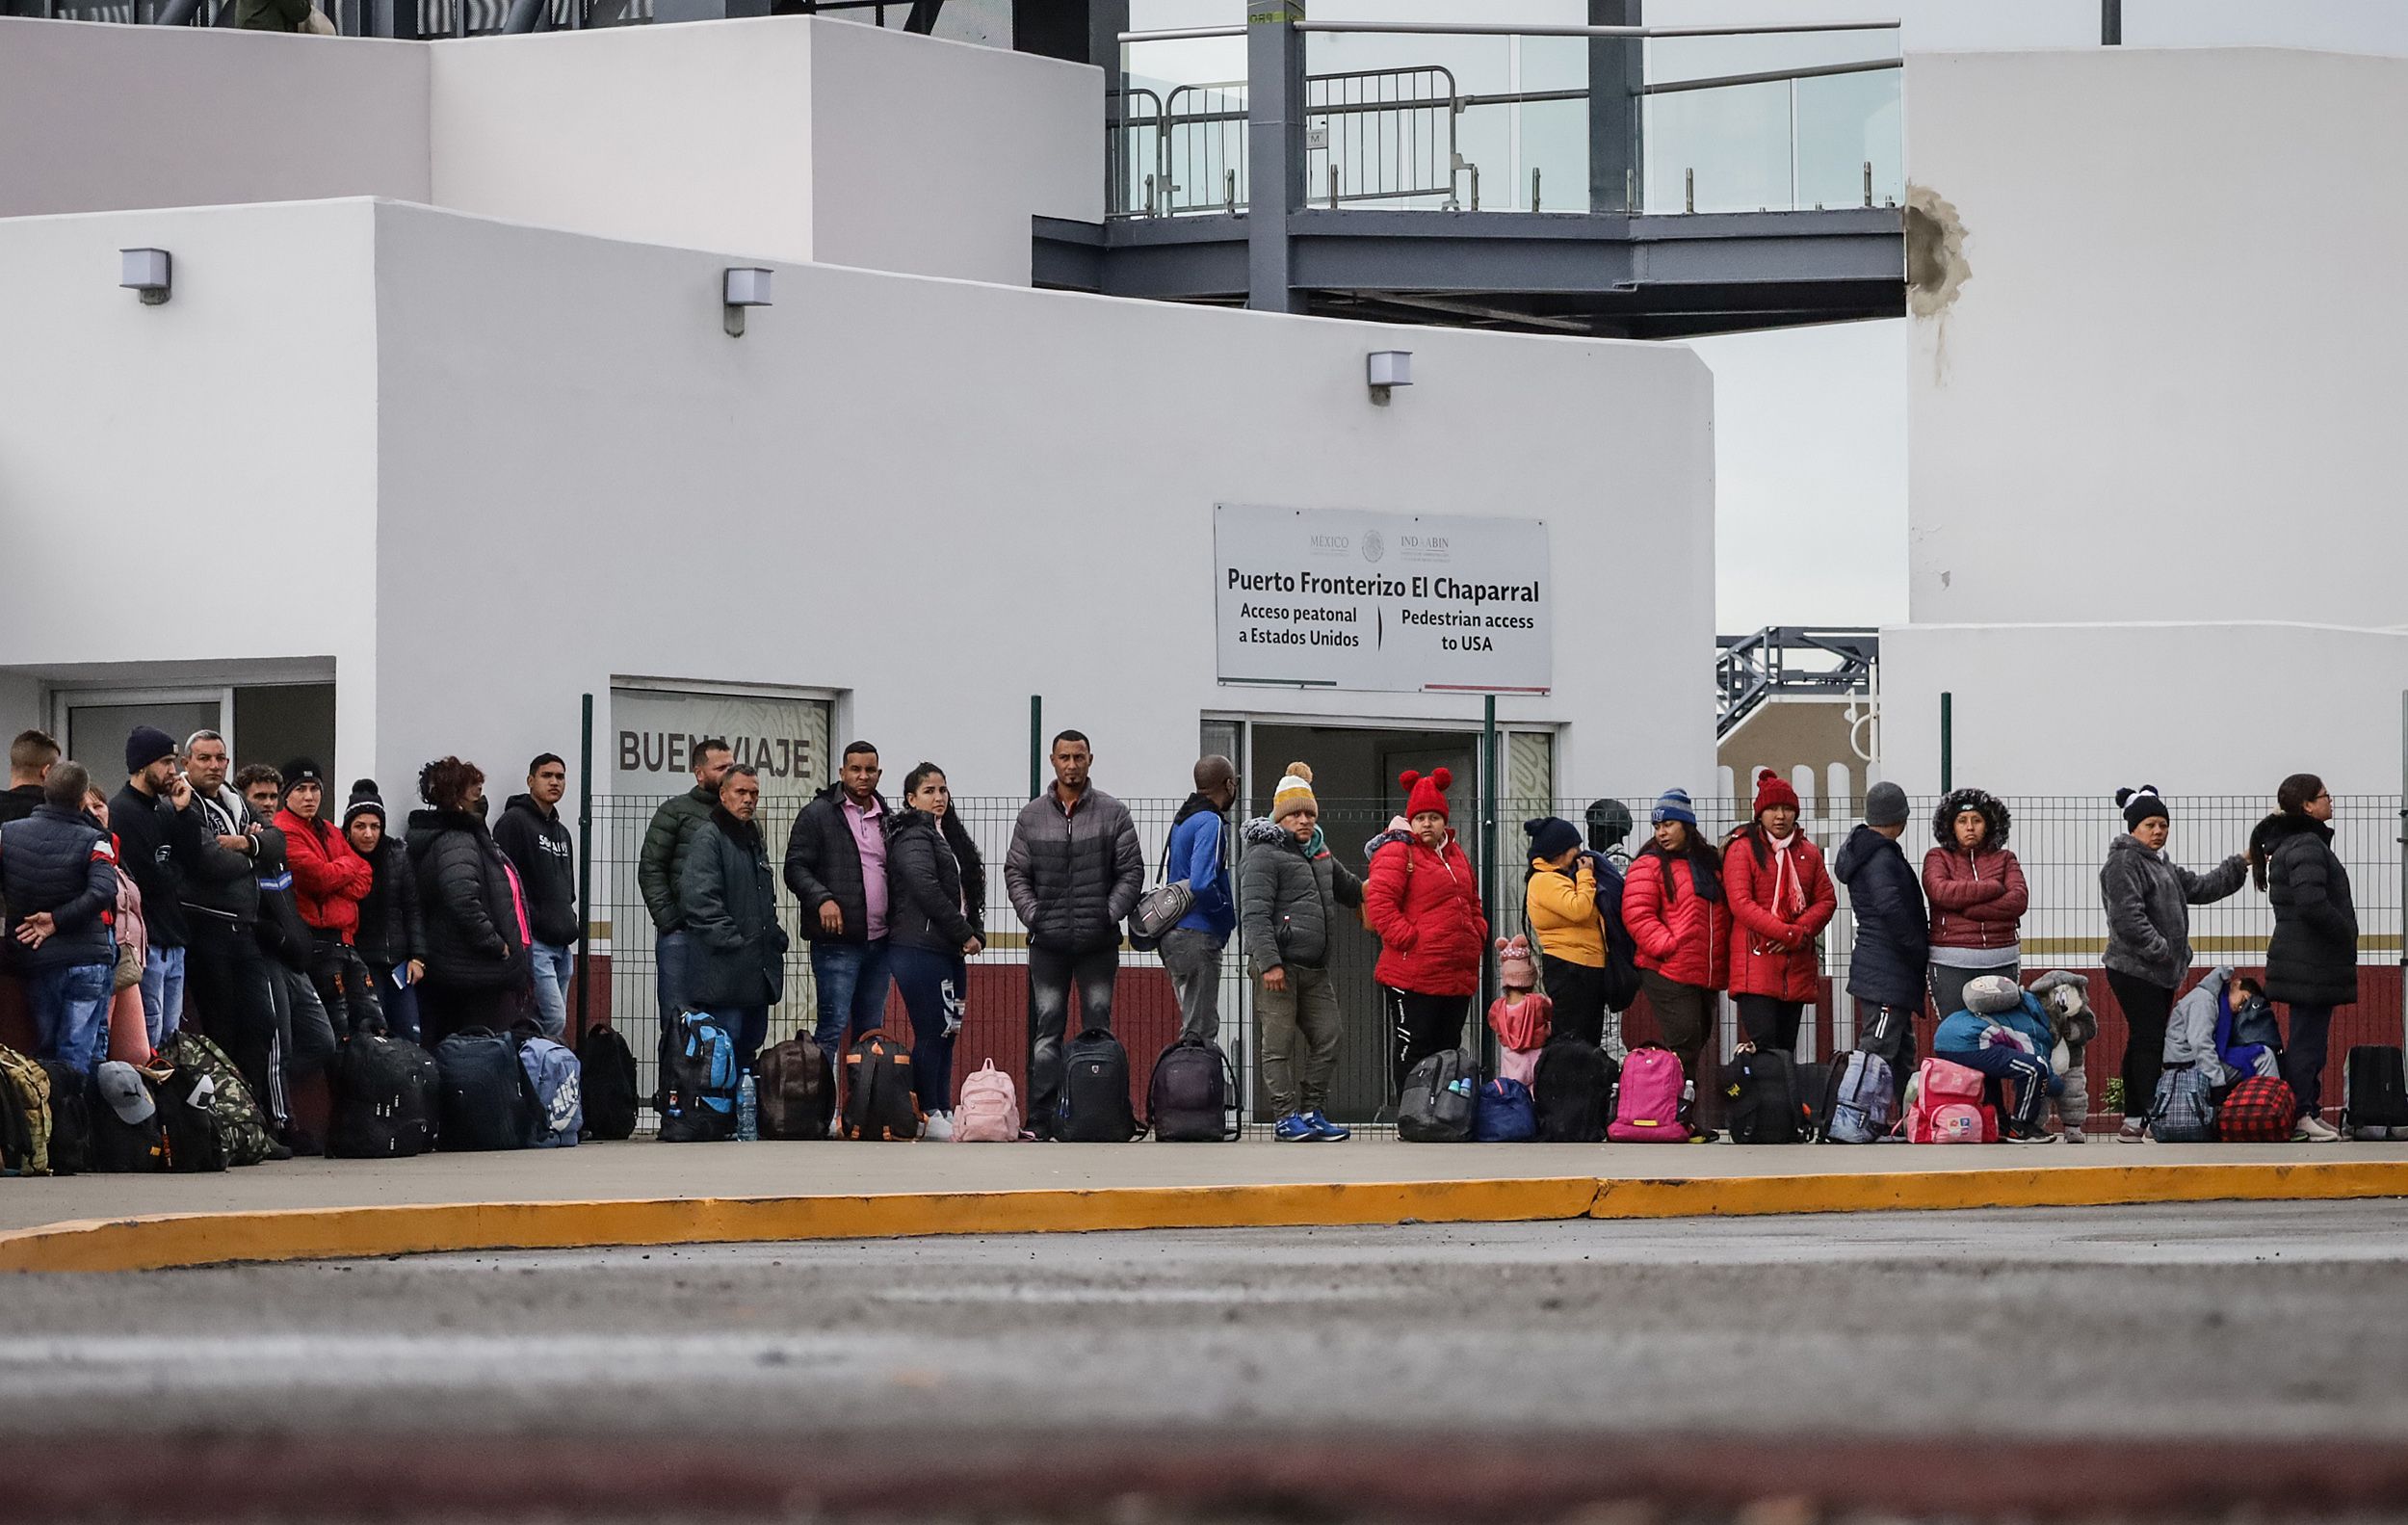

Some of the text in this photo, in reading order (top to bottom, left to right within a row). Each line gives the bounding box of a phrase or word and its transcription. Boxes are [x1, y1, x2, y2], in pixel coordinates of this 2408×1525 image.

[1400, 536, 1450, 549] INDABIN
[1228, 568, 1539, 606] Puerto Fronterizo El Chaparral
[1241, 602, 1357, 624] Acceso peatonal
[1401, 609, 1534, 629] Pedestrian access
[1239, 627, 1359, 647] a Estados Unidos
[1442, 635, 1493, 651] to USA
